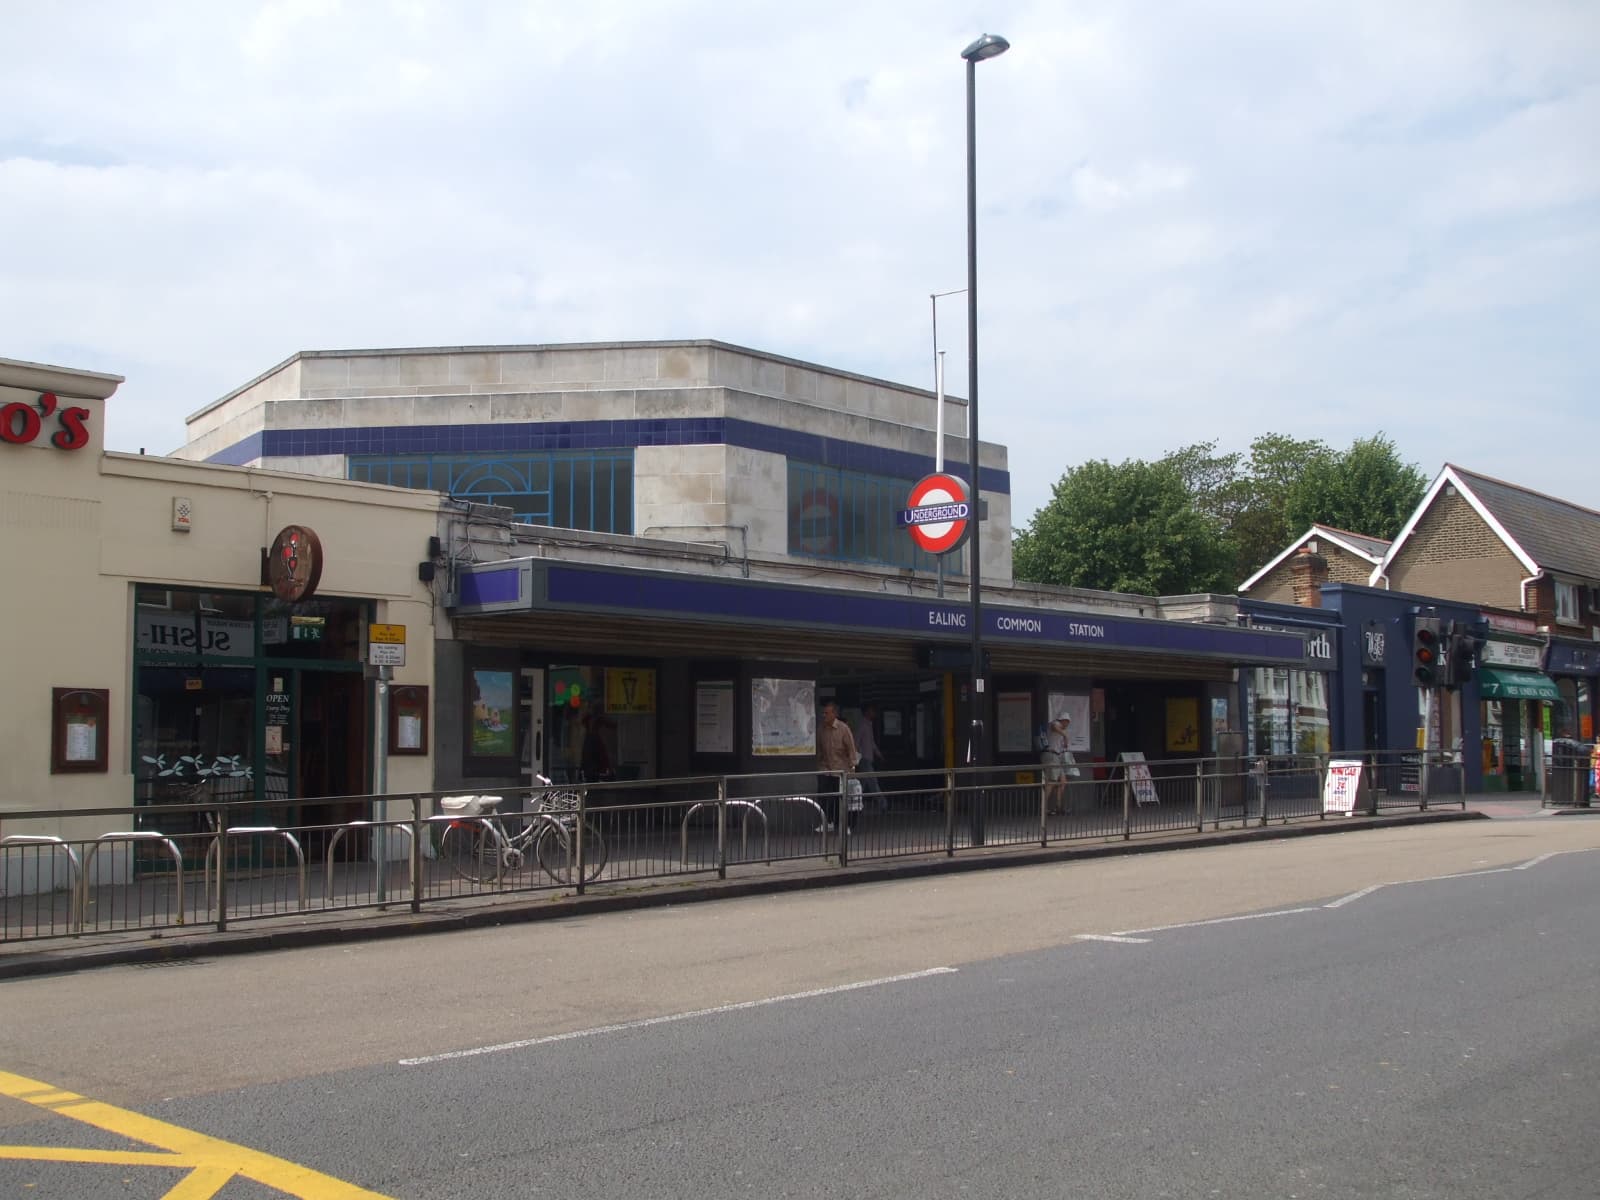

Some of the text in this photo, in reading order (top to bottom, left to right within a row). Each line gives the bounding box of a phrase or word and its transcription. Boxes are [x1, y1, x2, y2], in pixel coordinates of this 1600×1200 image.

[905, 503, 968, 523] UNDERGROUND
[929, 611, 1105, 638] EALING COMMON STATION
[266, 694, 290, 703] OPEN
